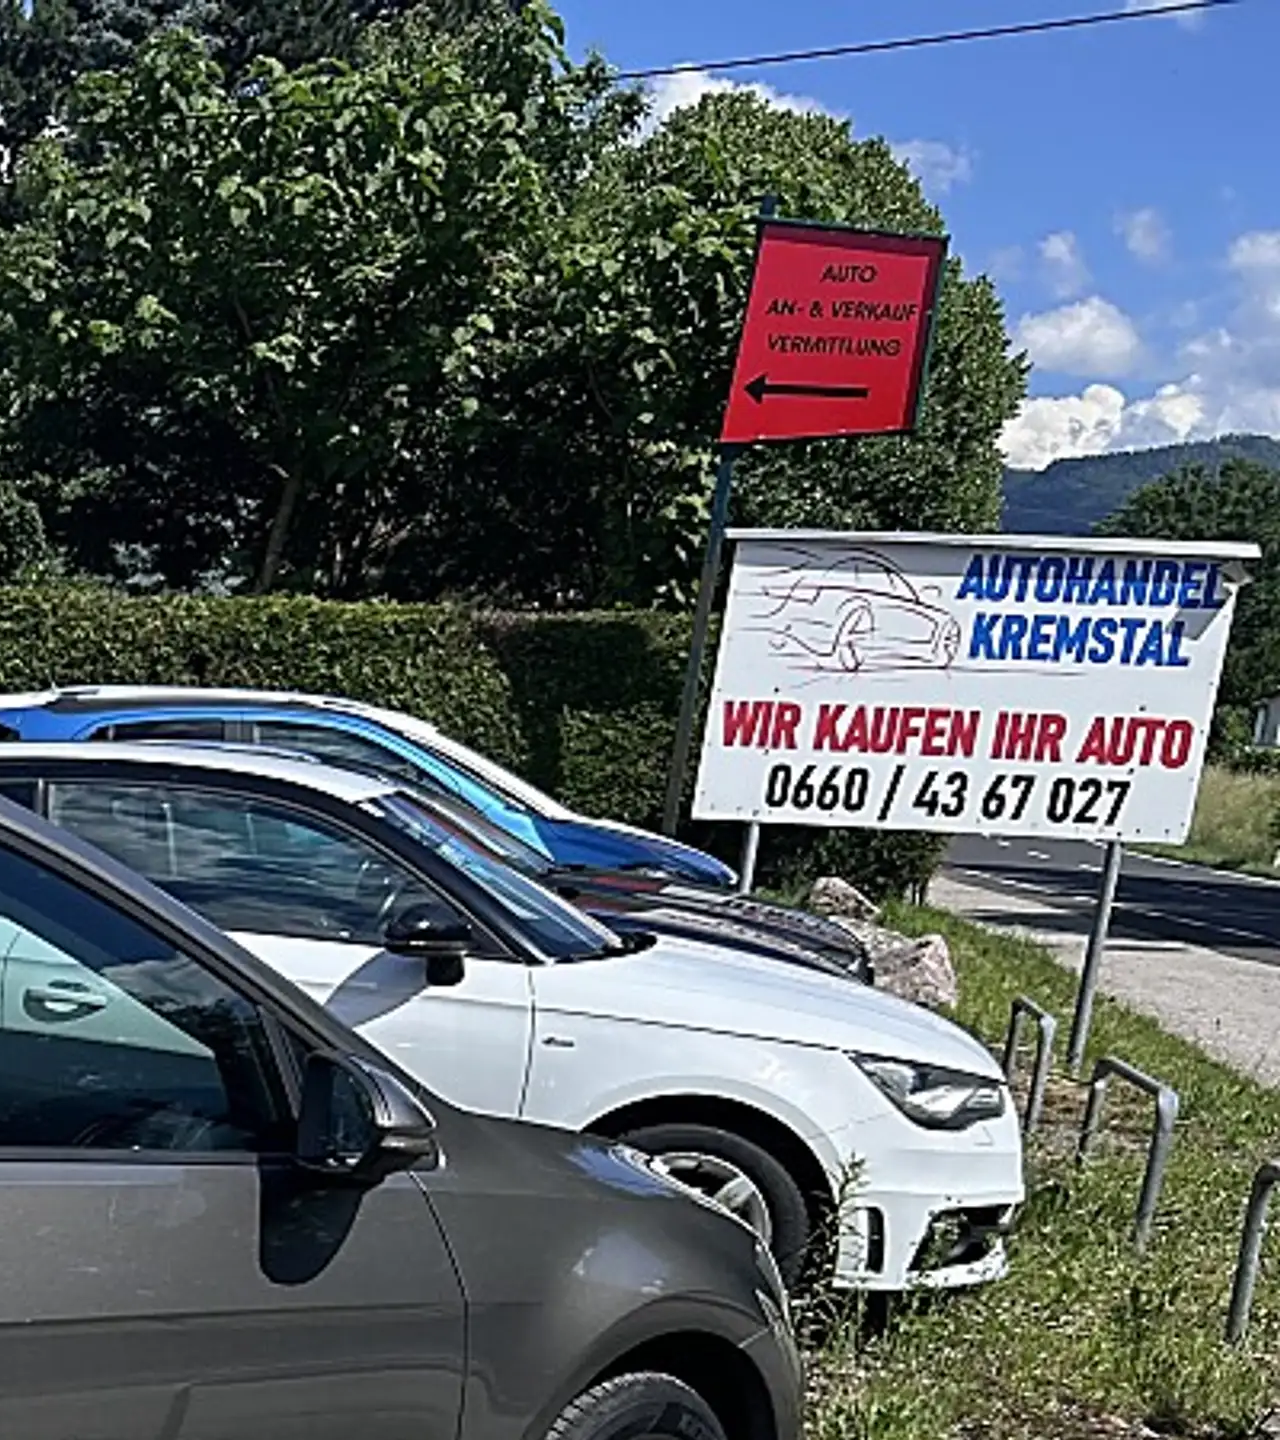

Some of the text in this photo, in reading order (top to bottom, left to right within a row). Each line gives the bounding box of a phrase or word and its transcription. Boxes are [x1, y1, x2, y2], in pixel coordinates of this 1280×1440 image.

[821, 265, 877, 283] AUTO
[766, 299, 918, 321] AN- & VERKAUF
[768, 334, 901, 357] VERMITTLUNG
[955, 554, 1226, 609] AUTOHANDEL
[968, 611, 1190, 667] KREMSTAL
[723, 700, 1195, 769] WIR KAUFEN IHR AUTO
[764, 762, 1132, 827] 0660 / 43 67 027
